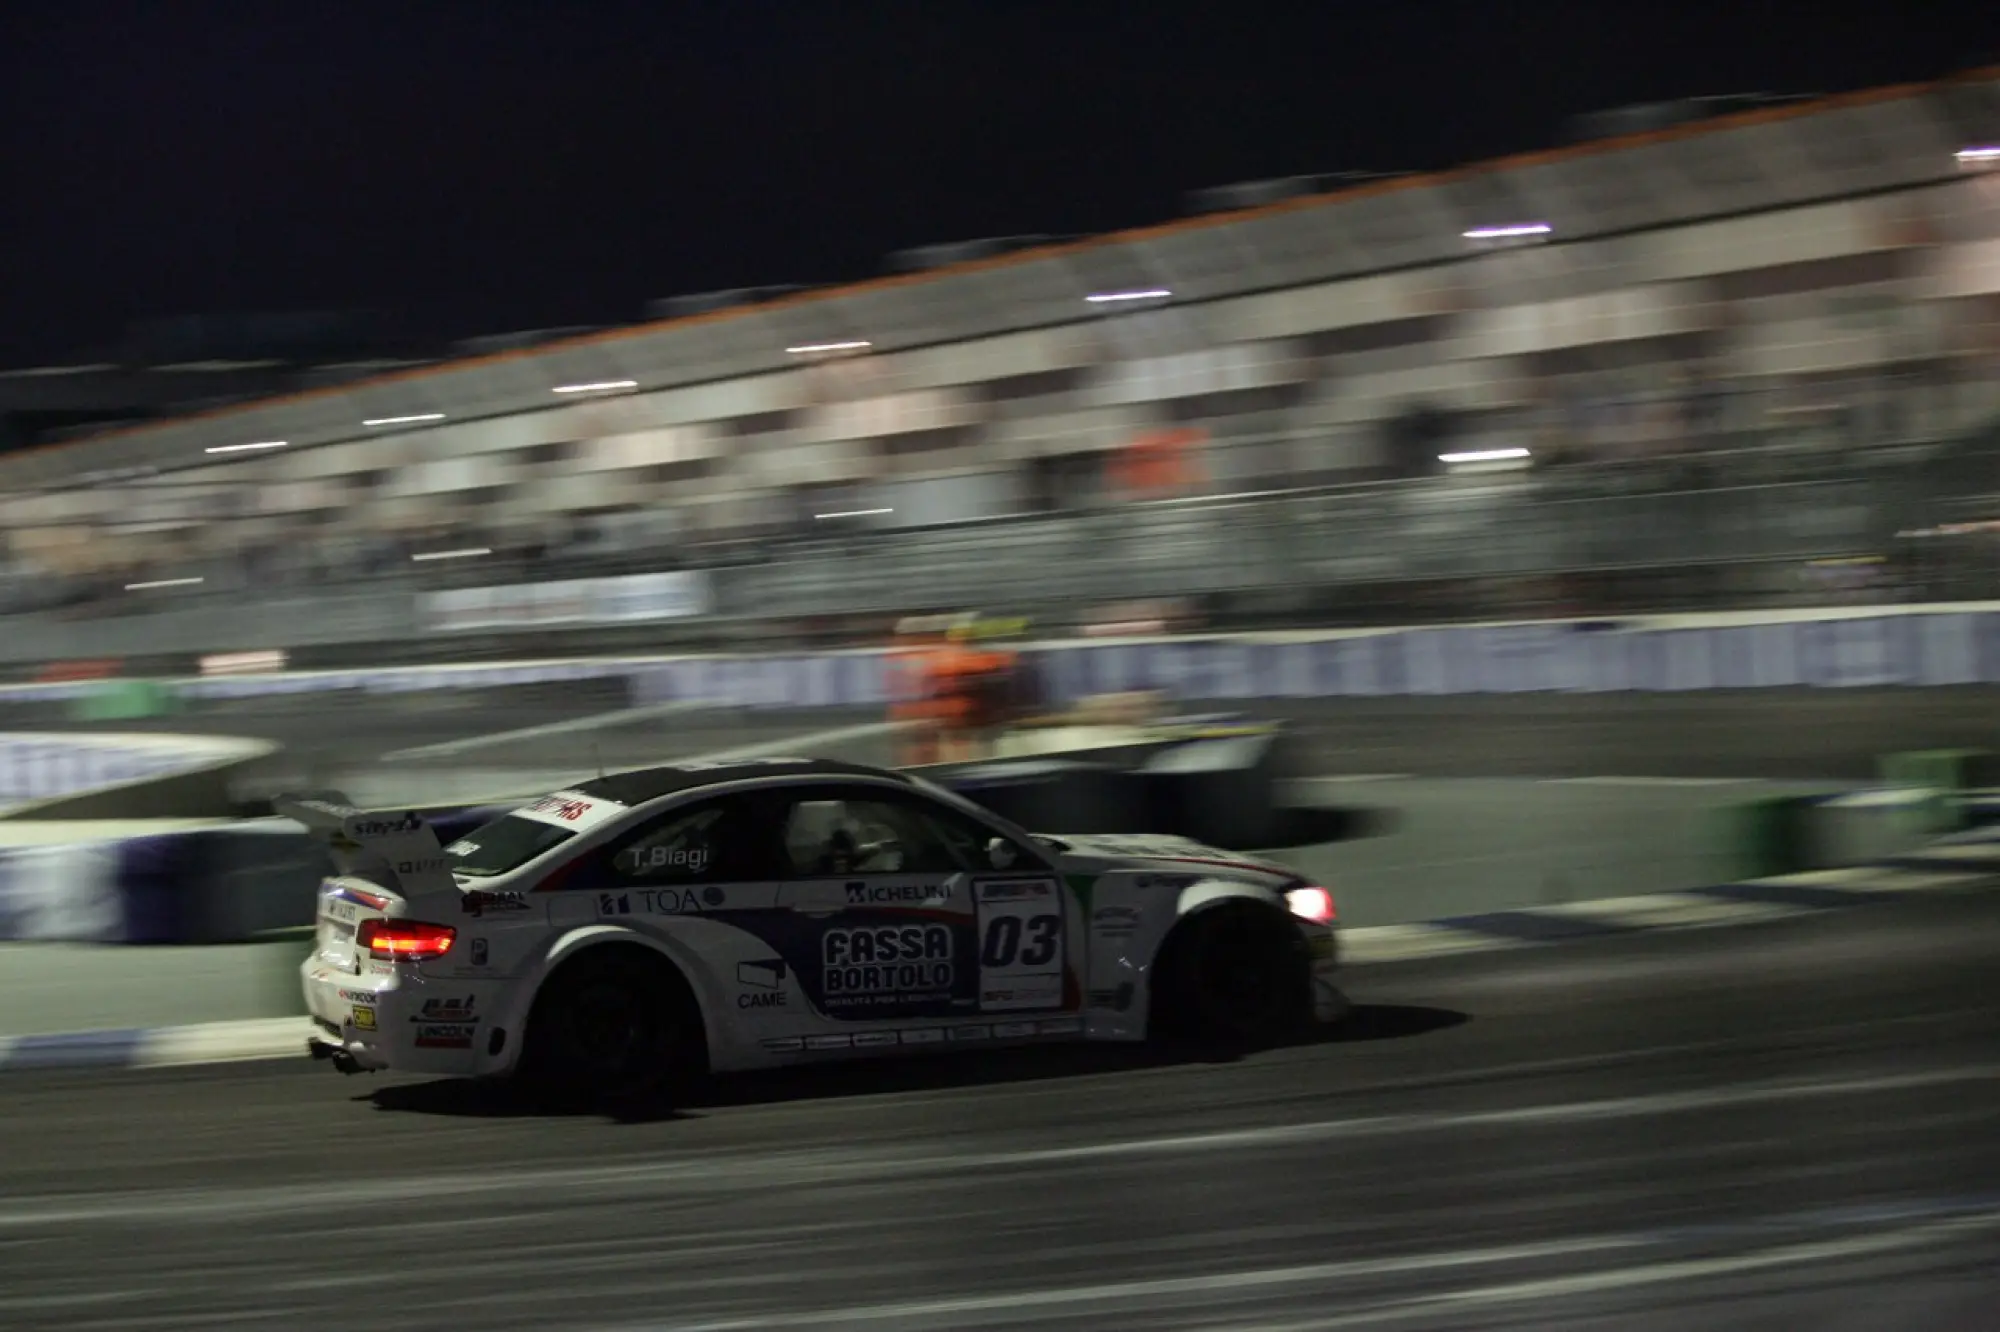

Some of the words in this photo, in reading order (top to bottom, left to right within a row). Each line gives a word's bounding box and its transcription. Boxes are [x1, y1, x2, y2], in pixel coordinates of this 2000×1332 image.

[626, 843, 710, 873] T.Biagi
[637, 889, 703, 912] TOA
[981, 914, 1061, 968] 03
[826, 963, 951, 991] BORTOLO
[738, 992, 787, 1009] CAME
